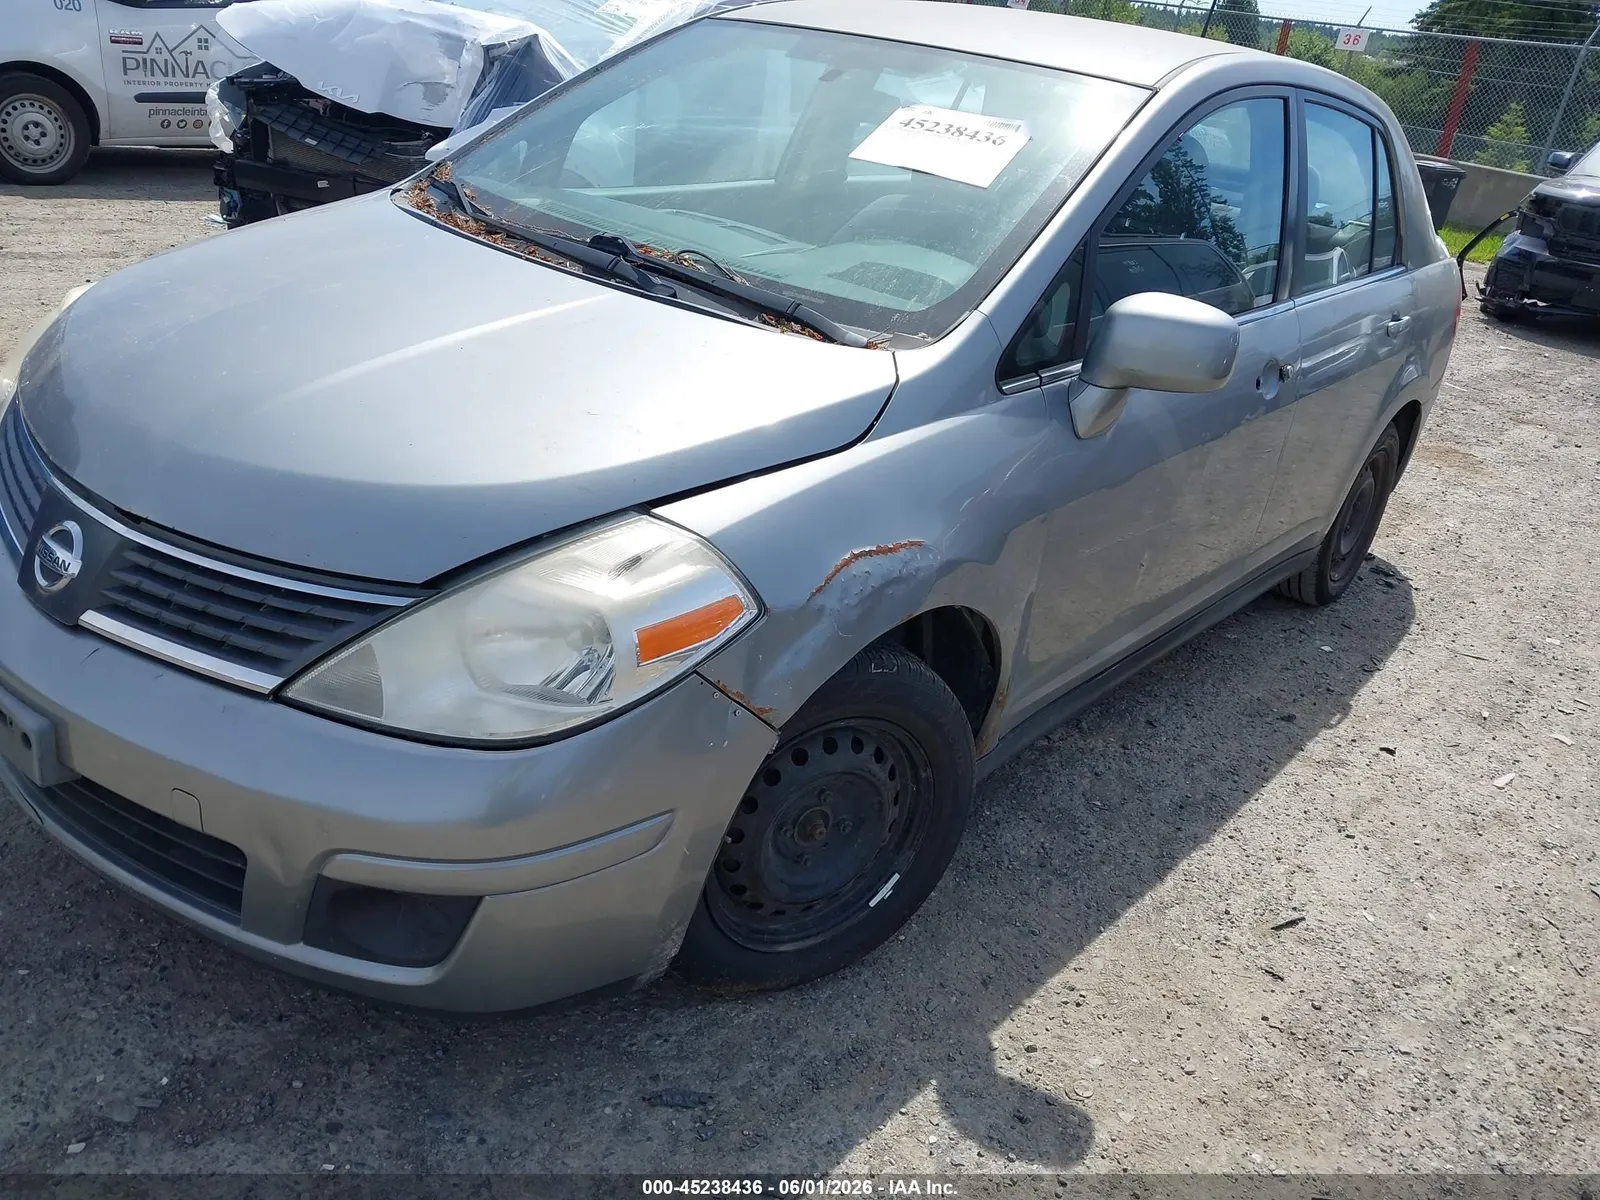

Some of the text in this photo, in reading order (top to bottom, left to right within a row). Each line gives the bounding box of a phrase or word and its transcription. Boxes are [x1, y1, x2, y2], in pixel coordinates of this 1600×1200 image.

[1343, 33, 1361, 46] 36
[898, 117, 1009, 147] 45238436
[37, 542, 72, 573] NISSAN
